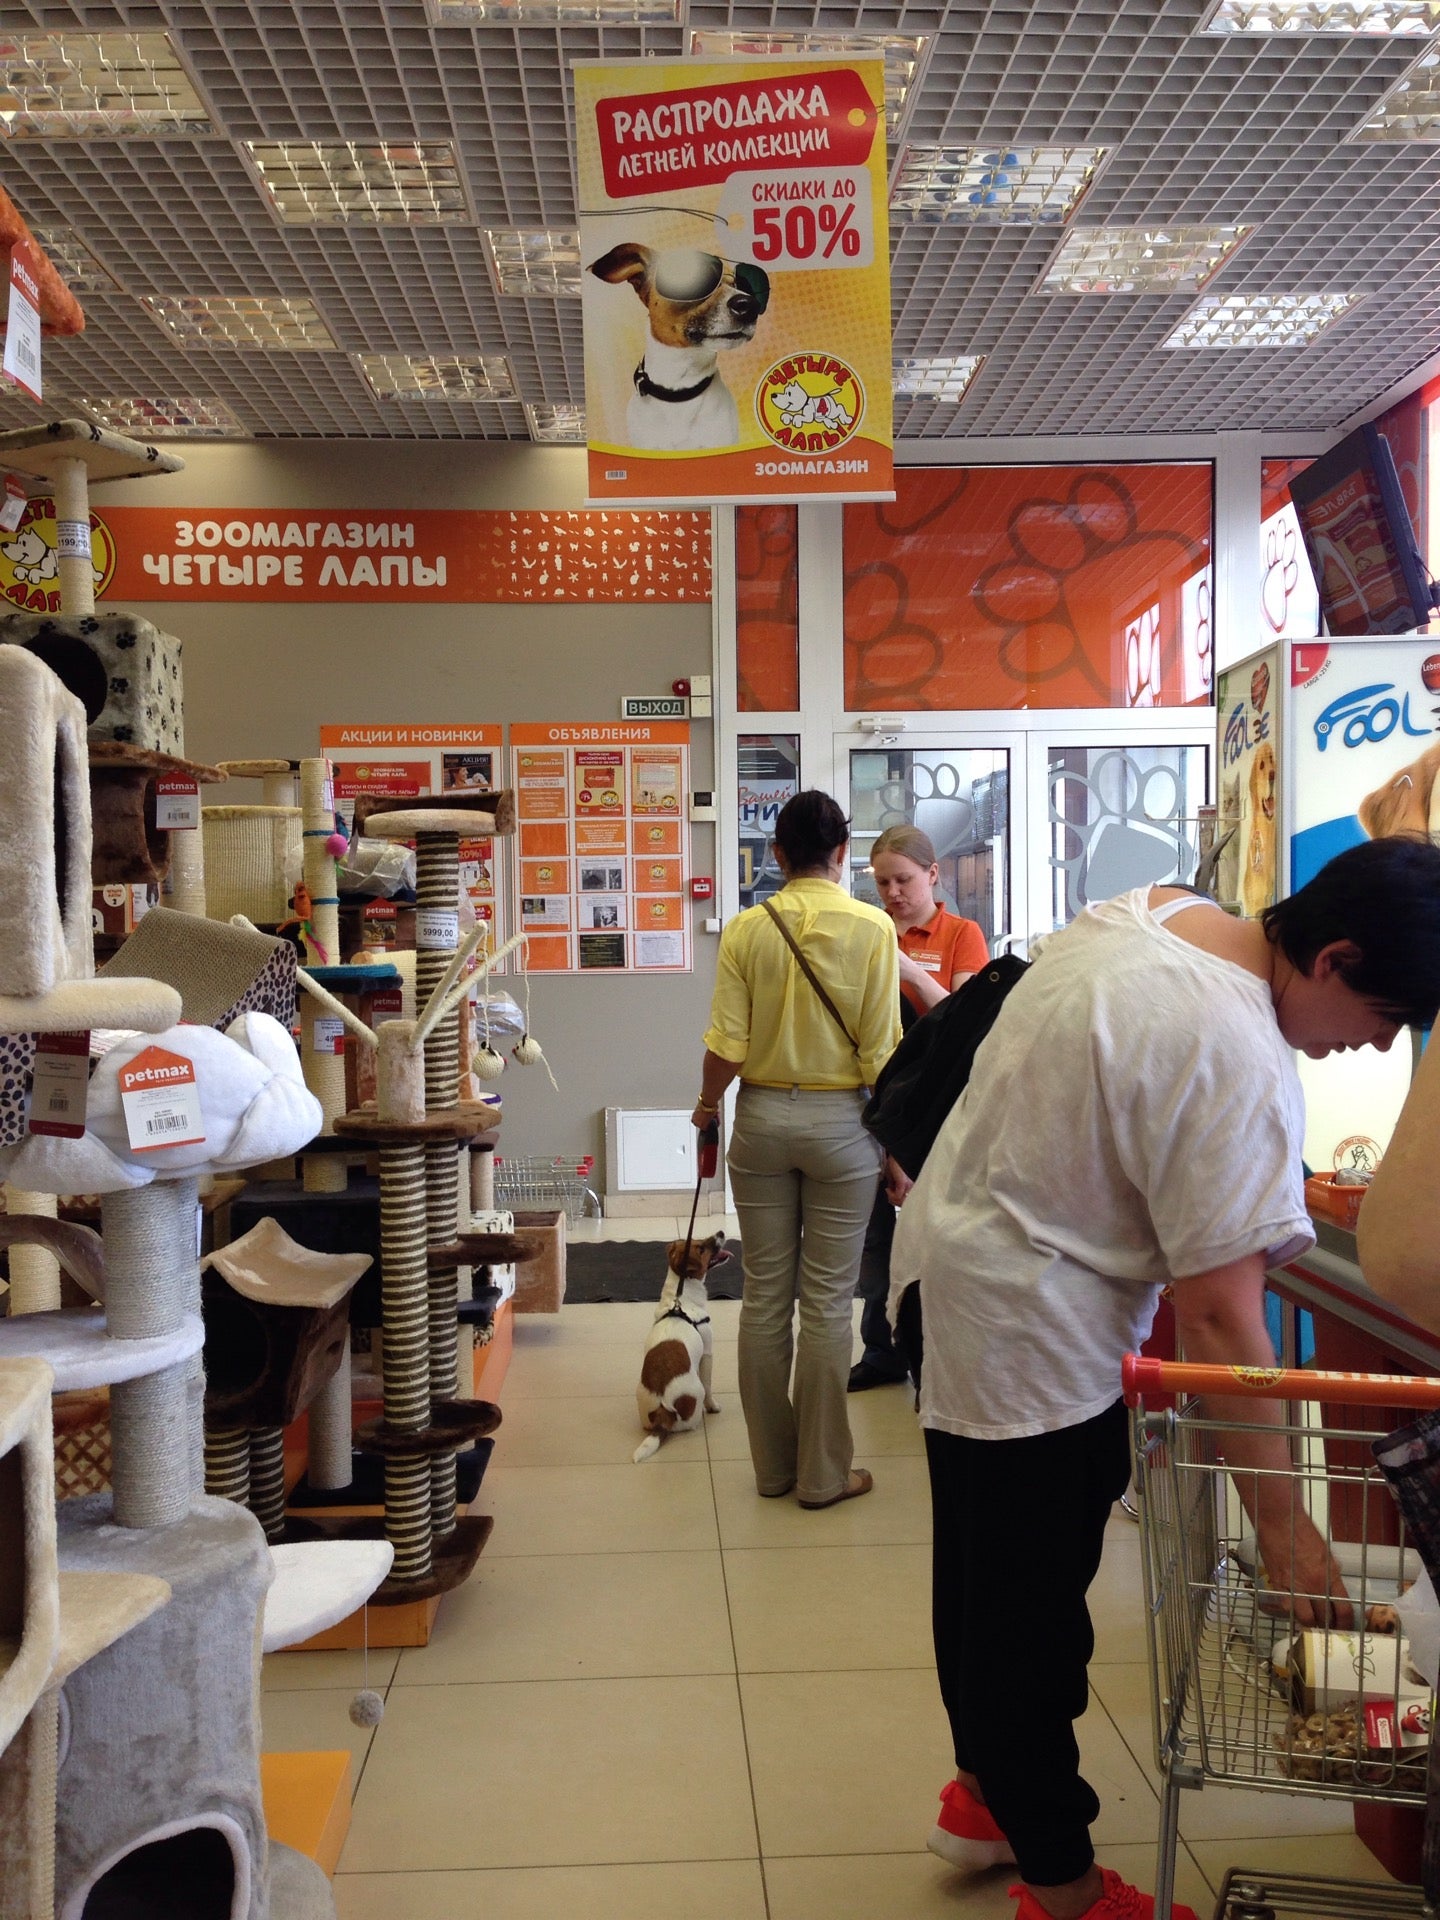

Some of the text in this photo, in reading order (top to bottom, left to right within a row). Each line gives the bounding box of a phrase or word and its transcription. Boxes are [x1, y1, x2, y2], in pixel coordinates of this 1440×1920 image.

[612, 85, 830, 144] РАСПРОДАЖА
[618, 127, 831, 179] ЛЕТНЕЙ КОЛЛЕКЦИИ
[752, 178, 856, 203] СКИДКИ ДО
[752, 203, 861, 262] 50%
[767, 353, 852, 387] ЧЕТЫРЕ
[775, 425, 849, 453] ЛАПЫ
[755, 460, 869, 476] ЗООМАГАЗИН
[175, 520, 415, 548] ЗООМАГАЗИН
[143, 554, 447, 587] ЧЕТЫРЕ ЛАПЫ
[1295, 650, 1310, 672] L
[628, 702, 682, 714] ВЫХОД
[341, 730, 484, 744] АКЦИИ И НОВИНКИ
[549, 728, 650, 740] ОБЪЯВЛЕНИЯ
[158, 781, 196, 791] petmax
[366, 906, 395, 916] petmax
[423, 928, 454, 938] 5999,00
[124, 1064, 190, 1088] petmax
